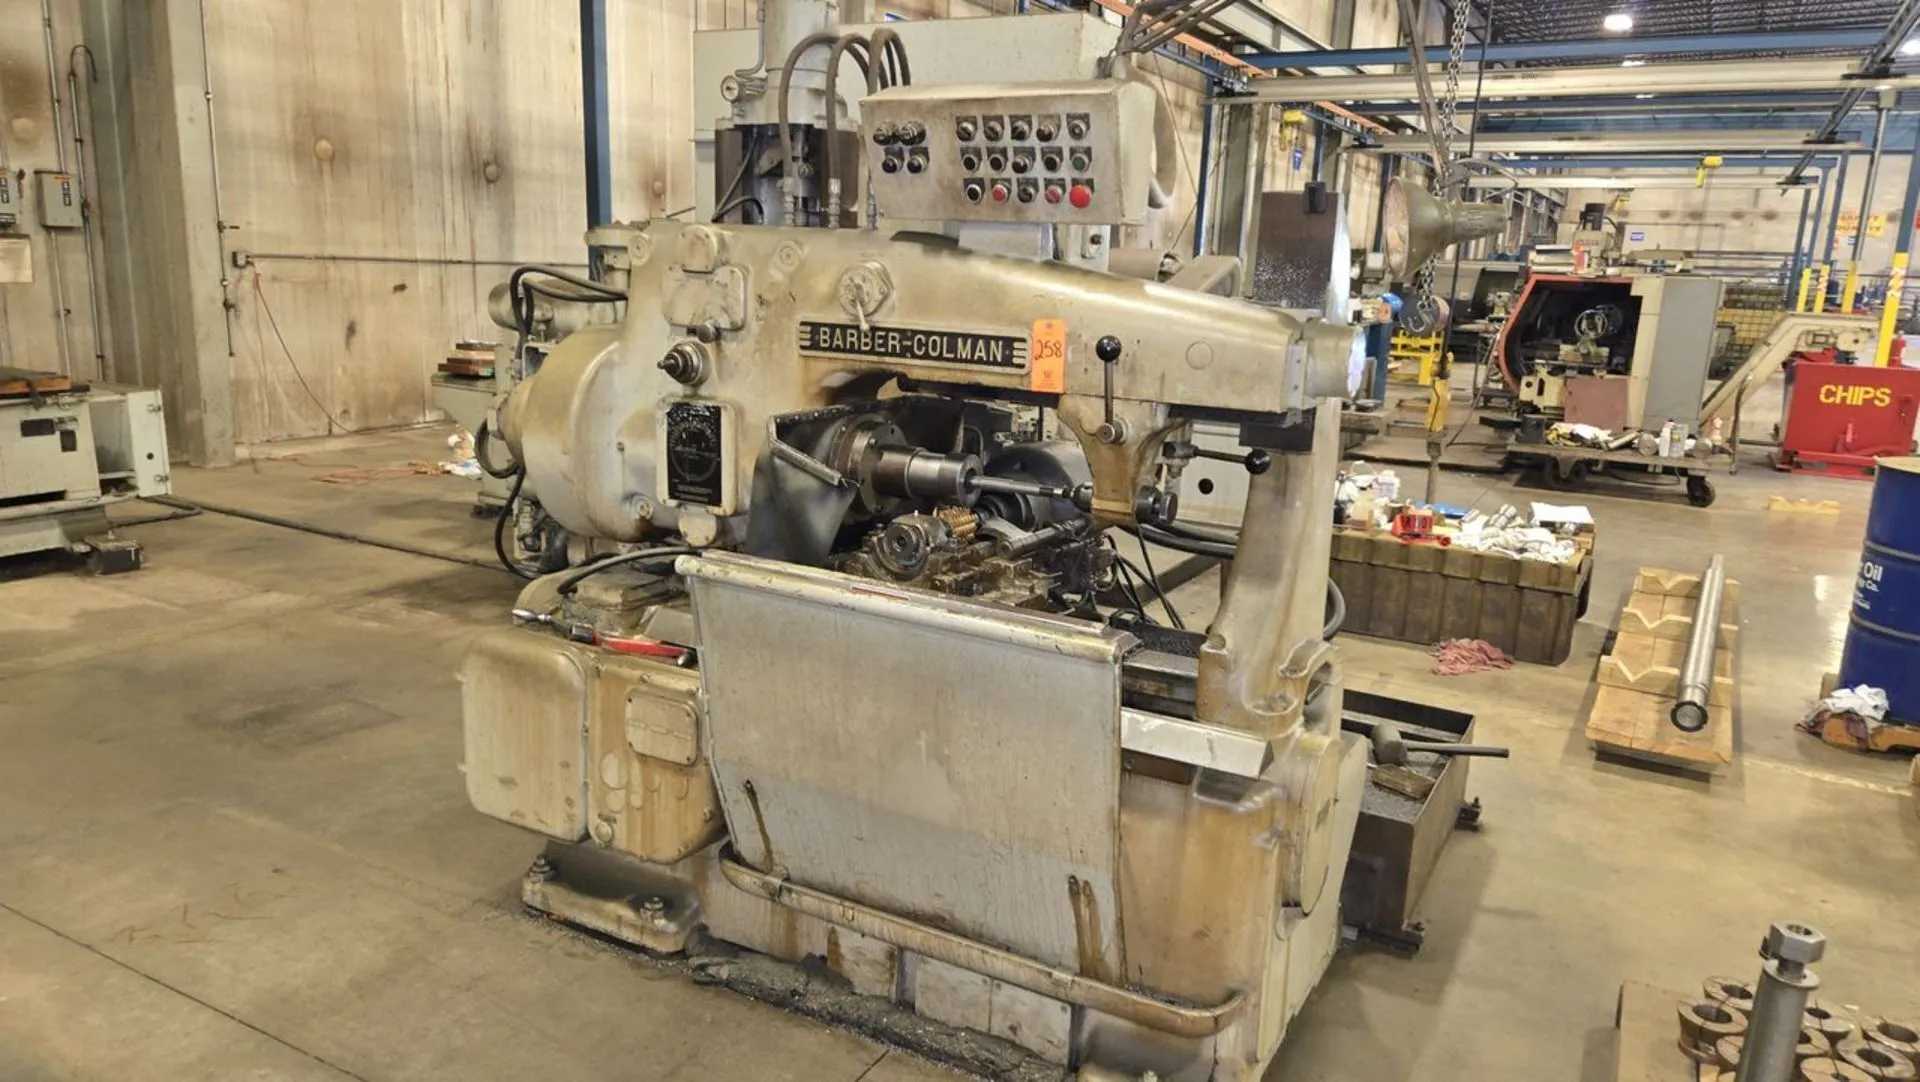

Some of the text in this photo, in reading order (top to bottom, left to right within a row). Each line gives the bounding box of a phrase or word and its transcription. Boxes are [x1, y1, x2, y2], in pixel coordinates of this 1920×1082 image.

[819, 327, 1004, 363] BARBER-COLMAN
[1034, 339, 1063, 361] 258
[1819, 384, 1892, 407] CHIPS
[1863, 561, 1883, 582] Oil
